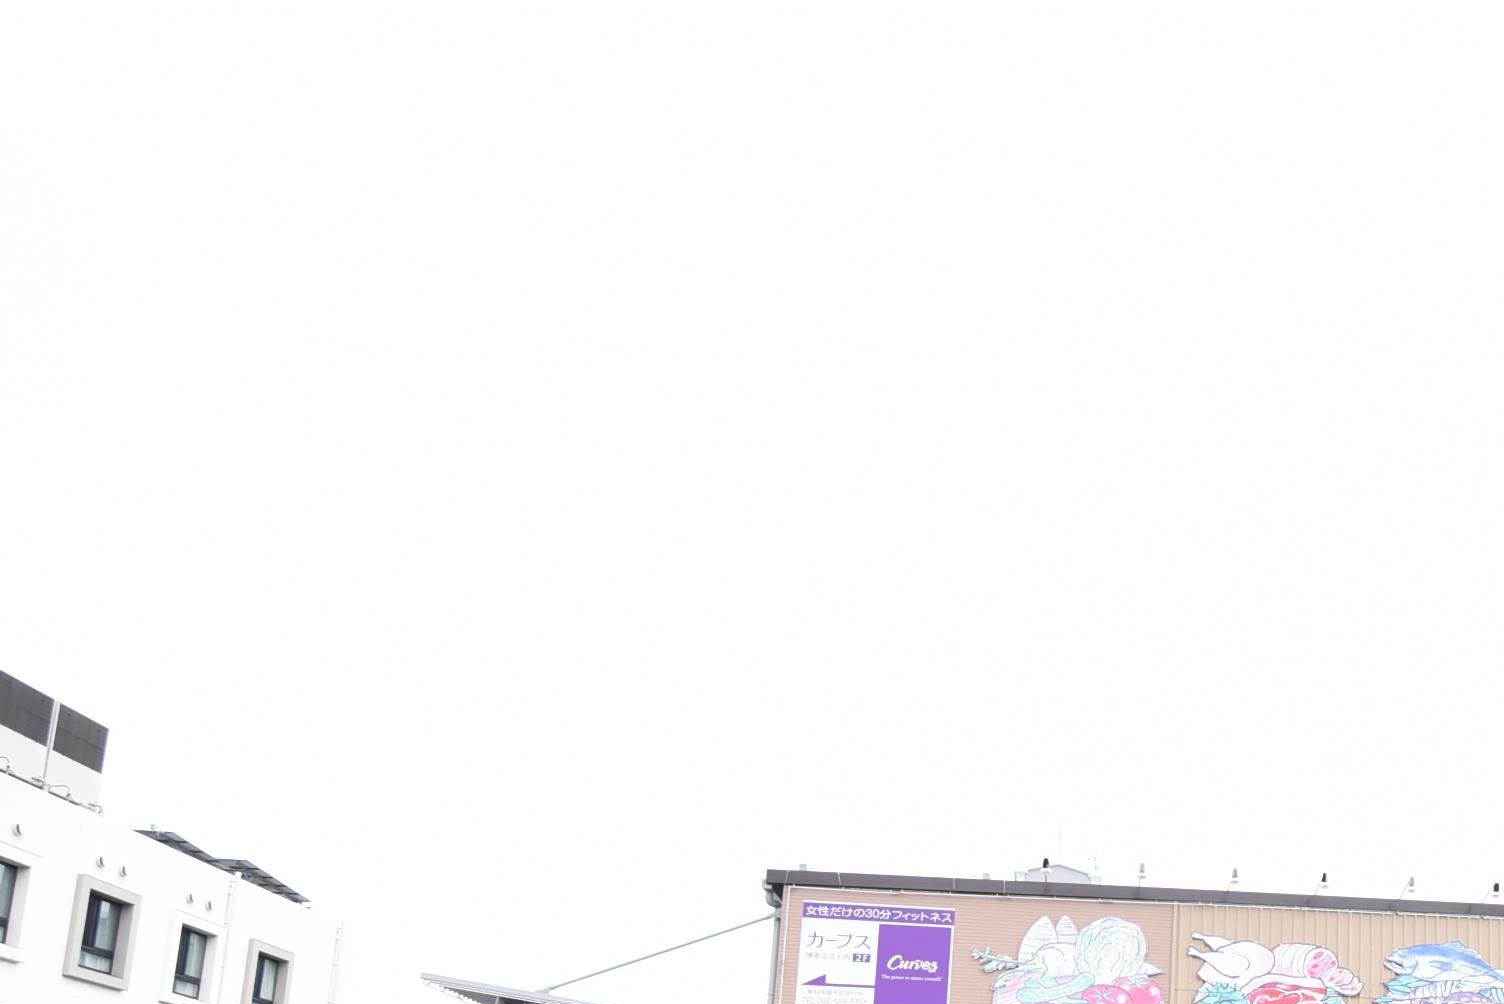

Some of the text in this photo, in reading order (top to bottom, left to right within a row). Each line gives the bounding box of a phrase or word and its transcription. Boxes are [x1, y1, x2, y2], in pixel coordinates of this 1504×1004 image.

[805, 905, 953, 923] 女性だけの30分フィットネス
[886, 954, 939, 973] Curves
